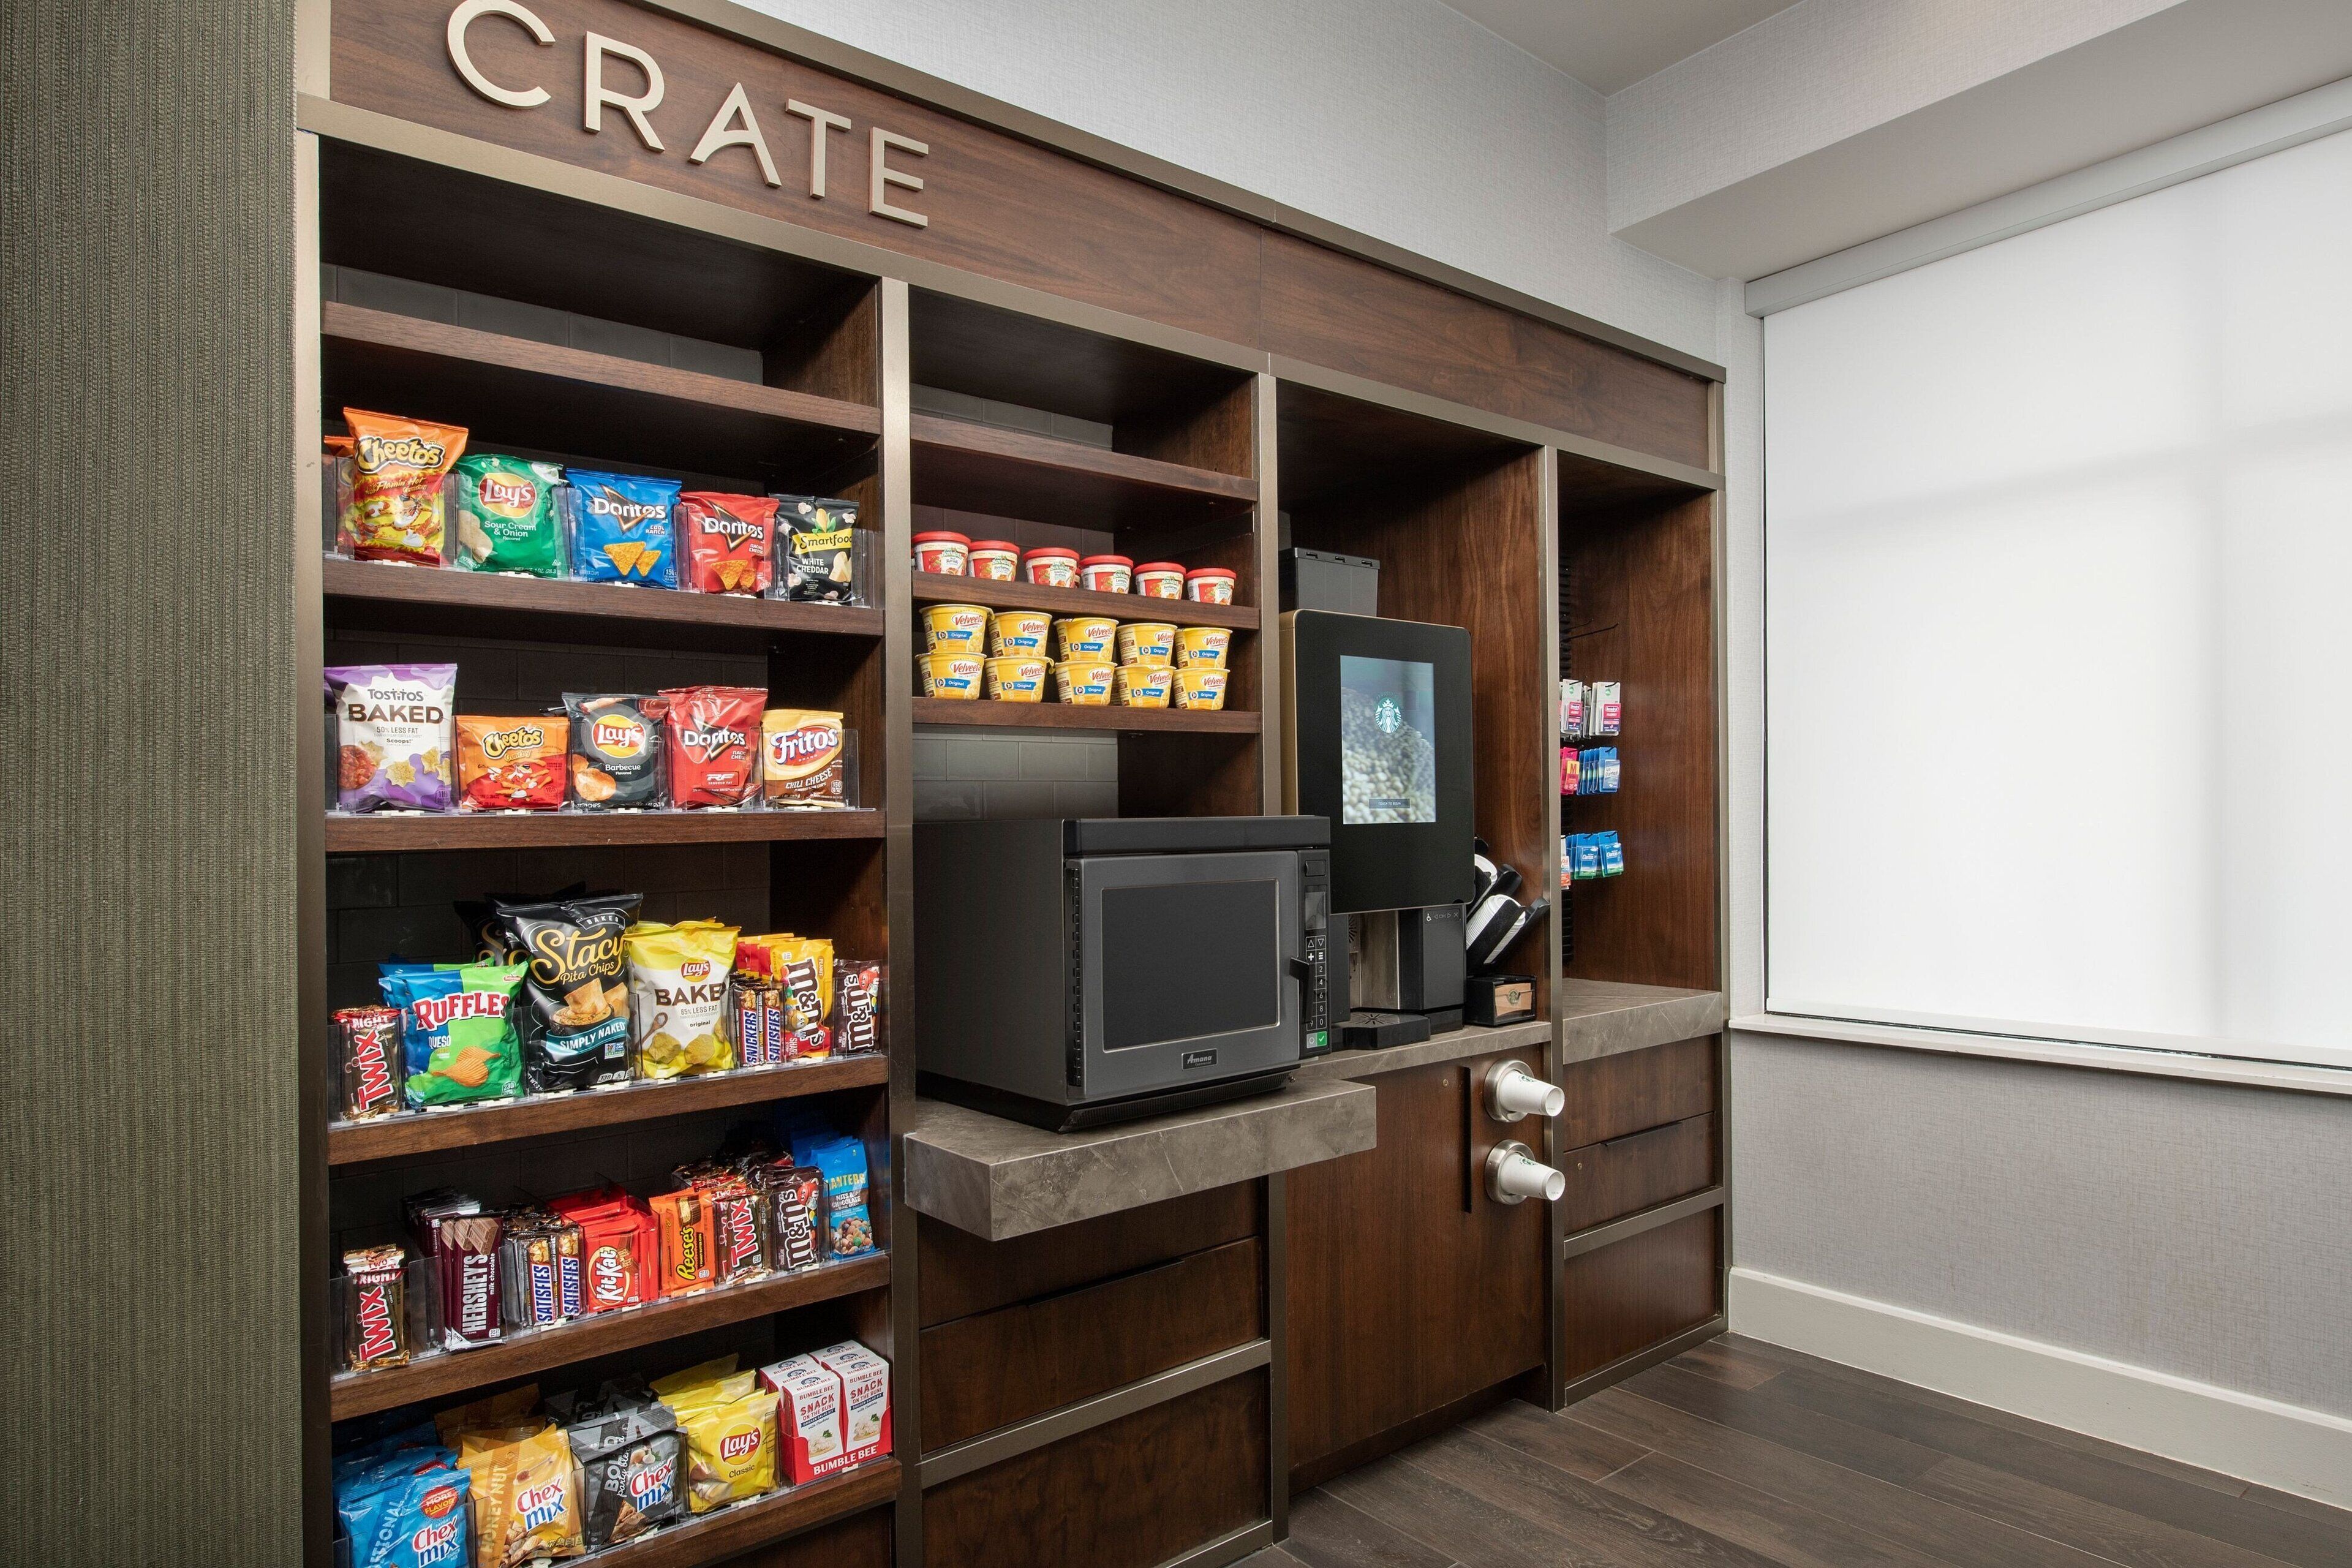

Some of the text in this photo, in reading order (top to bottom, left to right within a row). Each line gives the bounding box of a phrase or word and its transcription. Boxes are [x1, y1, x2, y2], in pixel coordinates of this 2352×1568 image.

[447, 0, 929, 230] CRATE
[356, 437, 443, 472] Cheetos
[484, 478, 532, 508] Lay's
[594, 497, 666, 519] Doritos
[502, 529, 528, 537] Onion
[508, 522, 537, 531] Cream
[704, 518, 764, 538] Doritos
[796, 565, 829, 575] CHEDDAR
[801, 557, 824, 567] WHITE
[955, 614, 984, 625] Velveeta
[1087, 627, 1113, 637] Velveeta
[952, 663, 981, 673] Velveeta
[348, 703, 443, 724] BAKED
[484, 727, 543, 757] Cheetos
[597, 724, 641, 748] Lay's
[684, 730, 745, 746] Doritos
[770, 728, 839, 765] Fritos
[504, 750, 532, 762] Crunchy
[785, 767, 834, 790] CHILI CHEESE
[587, 914, 619, 925] BAKED
[560, 961, 614, 985] Pita Chips
[682, 960, 710, 976] Lay's
[429, 1035, 451, 1049] QUESO
[560, 1020, 625, 1050] SIMPLY NAKED
[744, 1011, 758, 1064] SNICKERS
[768, 1009, 781, 1063] SATISFIES
[355, 1029, 394, 1112] TWIX
[1187, 1054, 1212, 1064] Amana
[715, 1189, 731, 1198] TWO
[829, 1173, 865, 1191] ANTERS
[731, 1197, 760, 1267] TWIX
[676, 1226, 696, 1281] Reese's
[358, 1271, 396, 1284] RIGHT
[562, 1257, 579, 1315] SATISFIES
[462, 1254, 488, 1333] HERSHEY'S
[533, 1264, 552, 1323] SATISFIES
[359, 1285, 397, 1361] TWIX
[453, 1333, 464, 1343] KING
[850, 1369, 883, 1384] BUMBLE BEE
[799, 1388, 823, 1400] BUMBLE
[850, 1377, 884, 1400] SNACK
[860, 1392, 870, 1401] THE
[870, 1387, 882, 1398] RUN!
[800, 1393, 835, 1416] SNACK
[811, 1409, 821, 1418] THE
[821, 1403, 834, 1414] RUN!
[723, 1431, 759, 1459] Lay's
[617, 1444, 633, 1498] party blen
[728, 1464, 755, 1479] Classic
[813, 1446, 877, 1476] BUMBLE BEE
[604, 1460, 620, 1492] BOL
[631, 1459, 673, 1496] Chex
[426, 1491, 453, 1506] MORE
[517, 1477, 563, 1513] Chex
[637, 1474, 672, 1513] mix
[424, 1498, 454, 1514] FLAVOR
[480, 1465, 508, 1553] HONEY NUT
[526, 1493, 566, 1531] mix
[412, 1516, 458, 1551] Chex
[420, 1532, 459, 1567] mix
